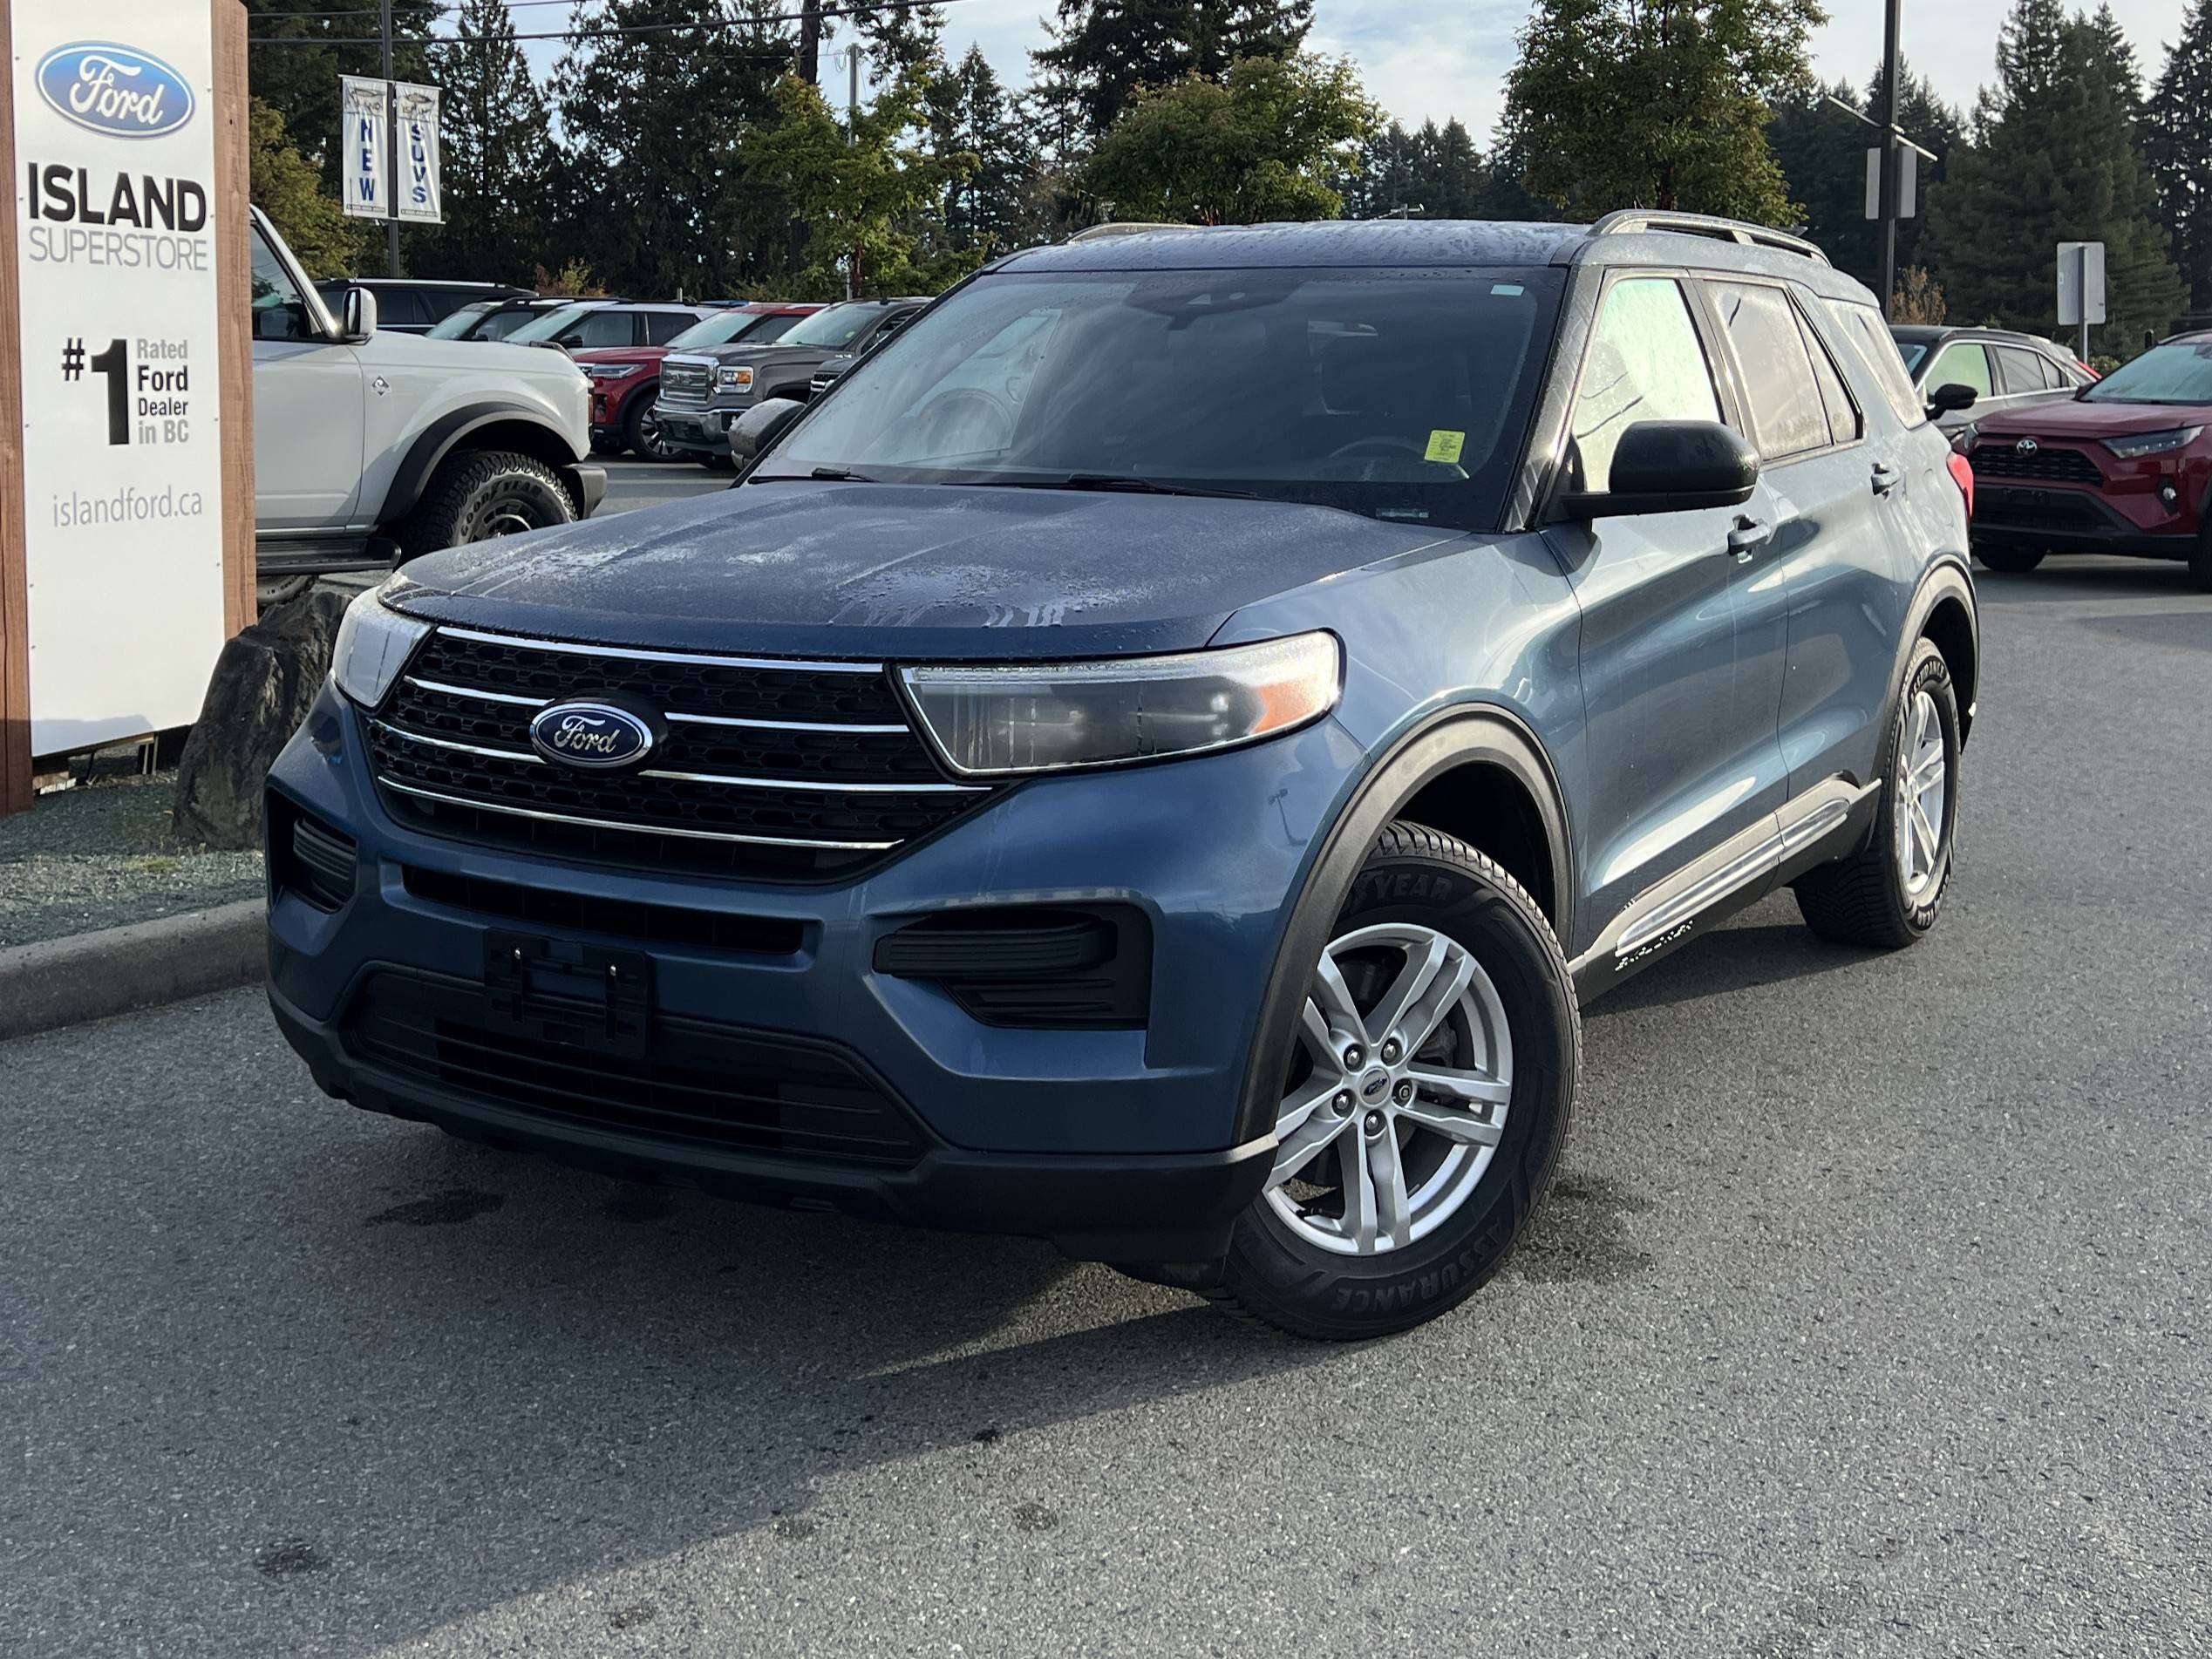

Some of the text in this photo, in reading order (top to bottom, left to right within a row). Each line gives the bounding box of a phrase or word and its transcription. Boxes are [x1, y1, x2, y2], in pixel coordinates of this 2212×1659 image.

[70, 55, 164, 125] Ford
[359, 119, 375, 201] NEW
[411, 123, 426, 203] SUVS
[28, 162, 207, 232] ISLAND
[29, 226, 208, 271] SUPERSTORE
[137, 338, 188, 359] Rated
[137, 364, 188, 391] Ford
[138, 397, 188, 416] Dealer
[138, 419, 189, 444] in BC
[53, 485, 203, 527] islandford.ca
[554, 715, 621, 753] Ford
